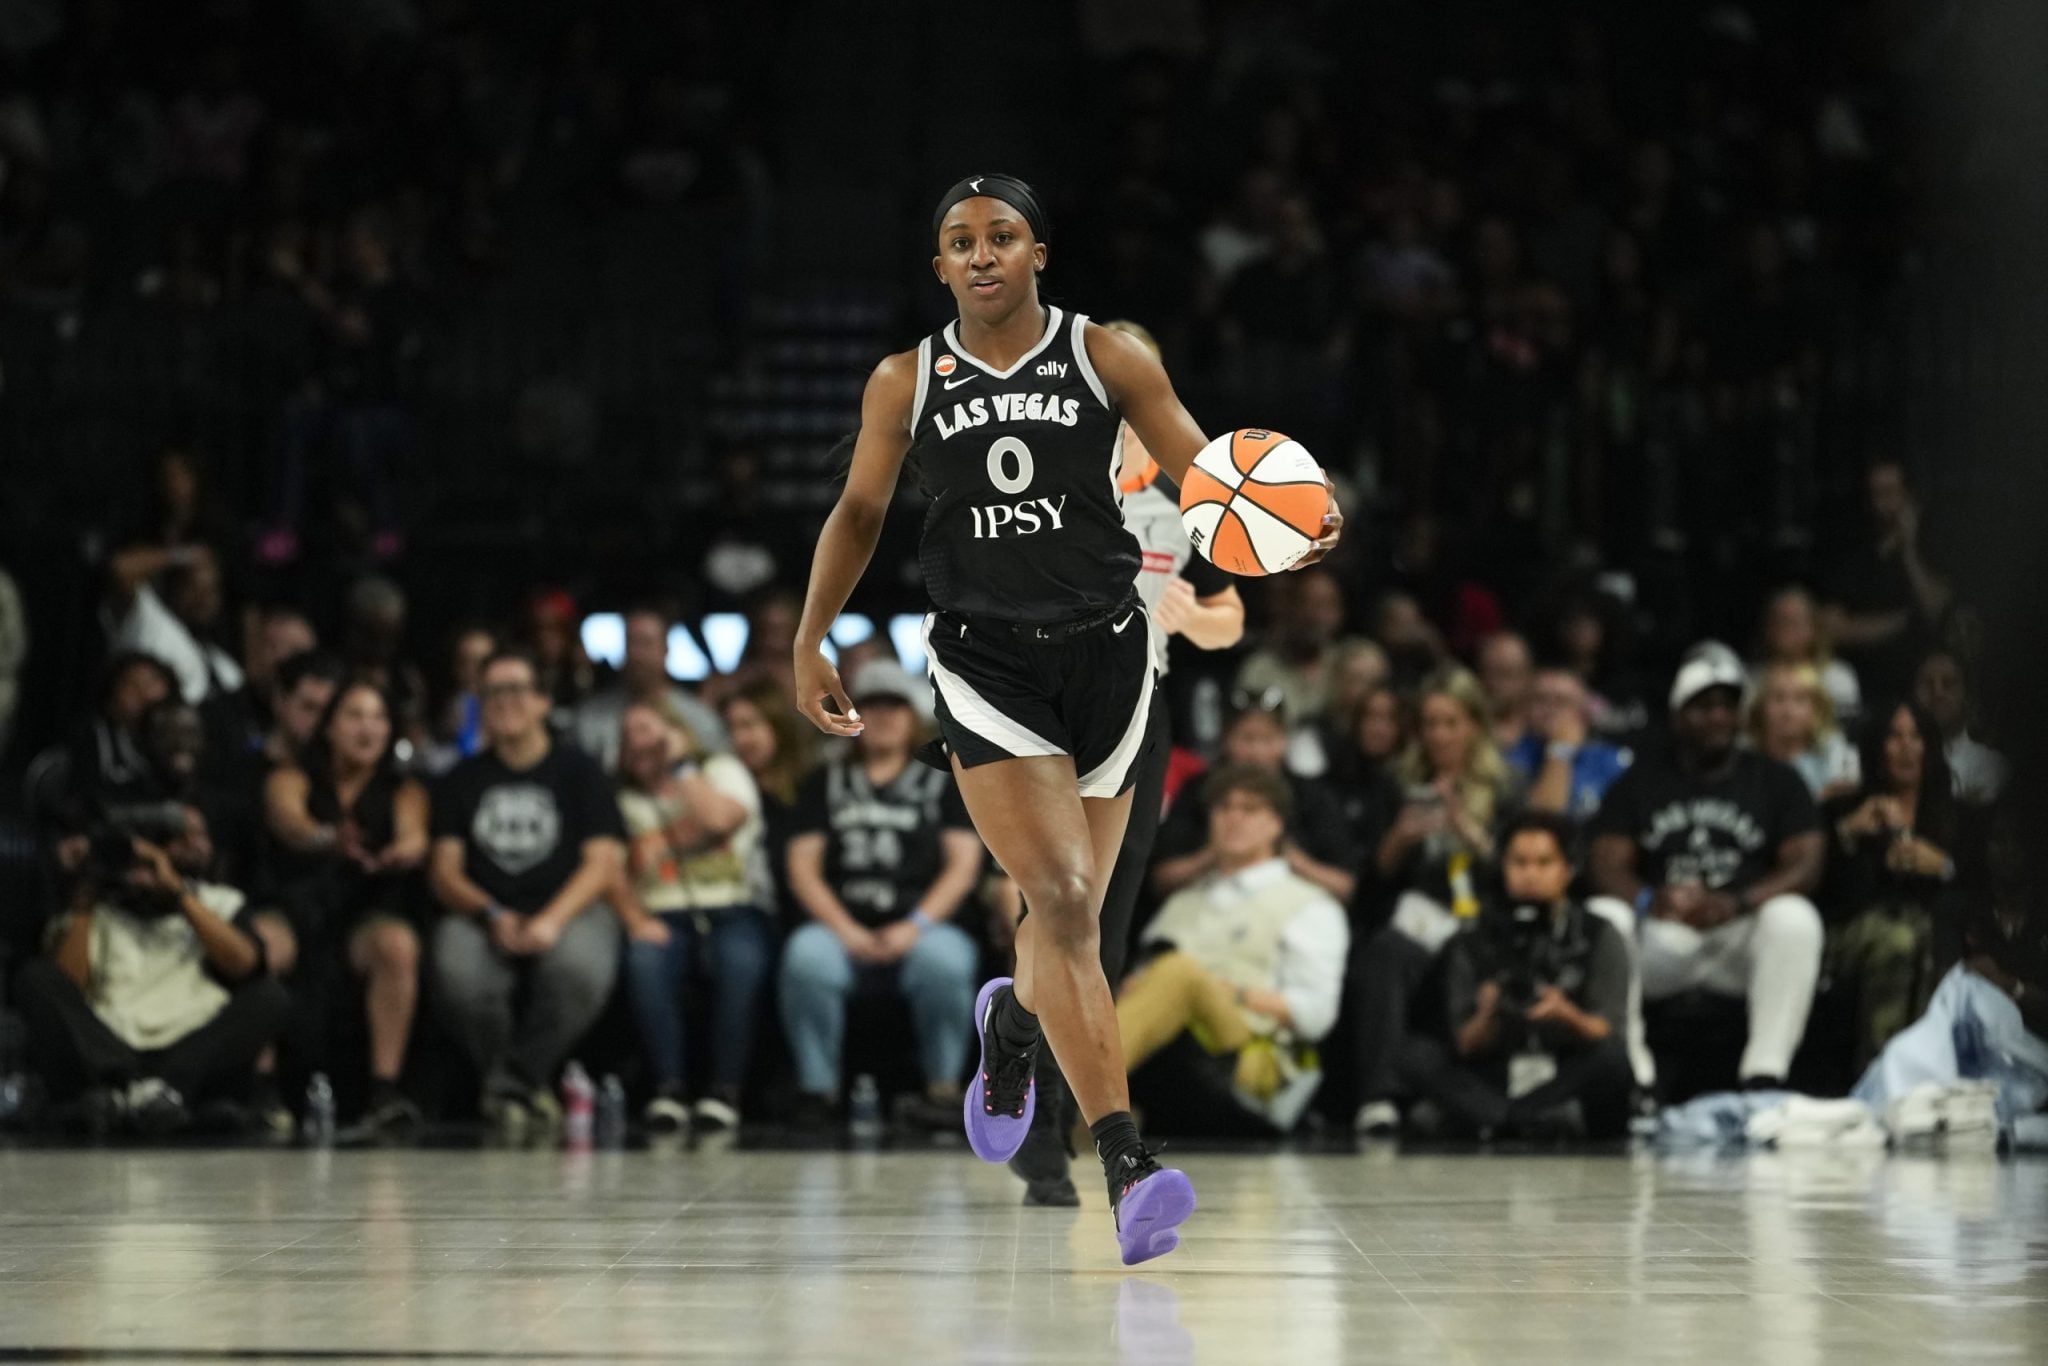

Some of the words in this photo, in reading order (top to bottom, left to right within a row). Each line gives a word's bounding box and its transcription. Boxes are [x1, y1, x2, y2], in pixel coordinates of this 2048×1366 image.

[1036, 361, 1068, 378] ally
[933, 397, 989, 440] LAS
[992, 393, 1080, 427] VEGAS
[986, 436, 1034, 494] 0
[970, 494, 1067, 539] IPSY
